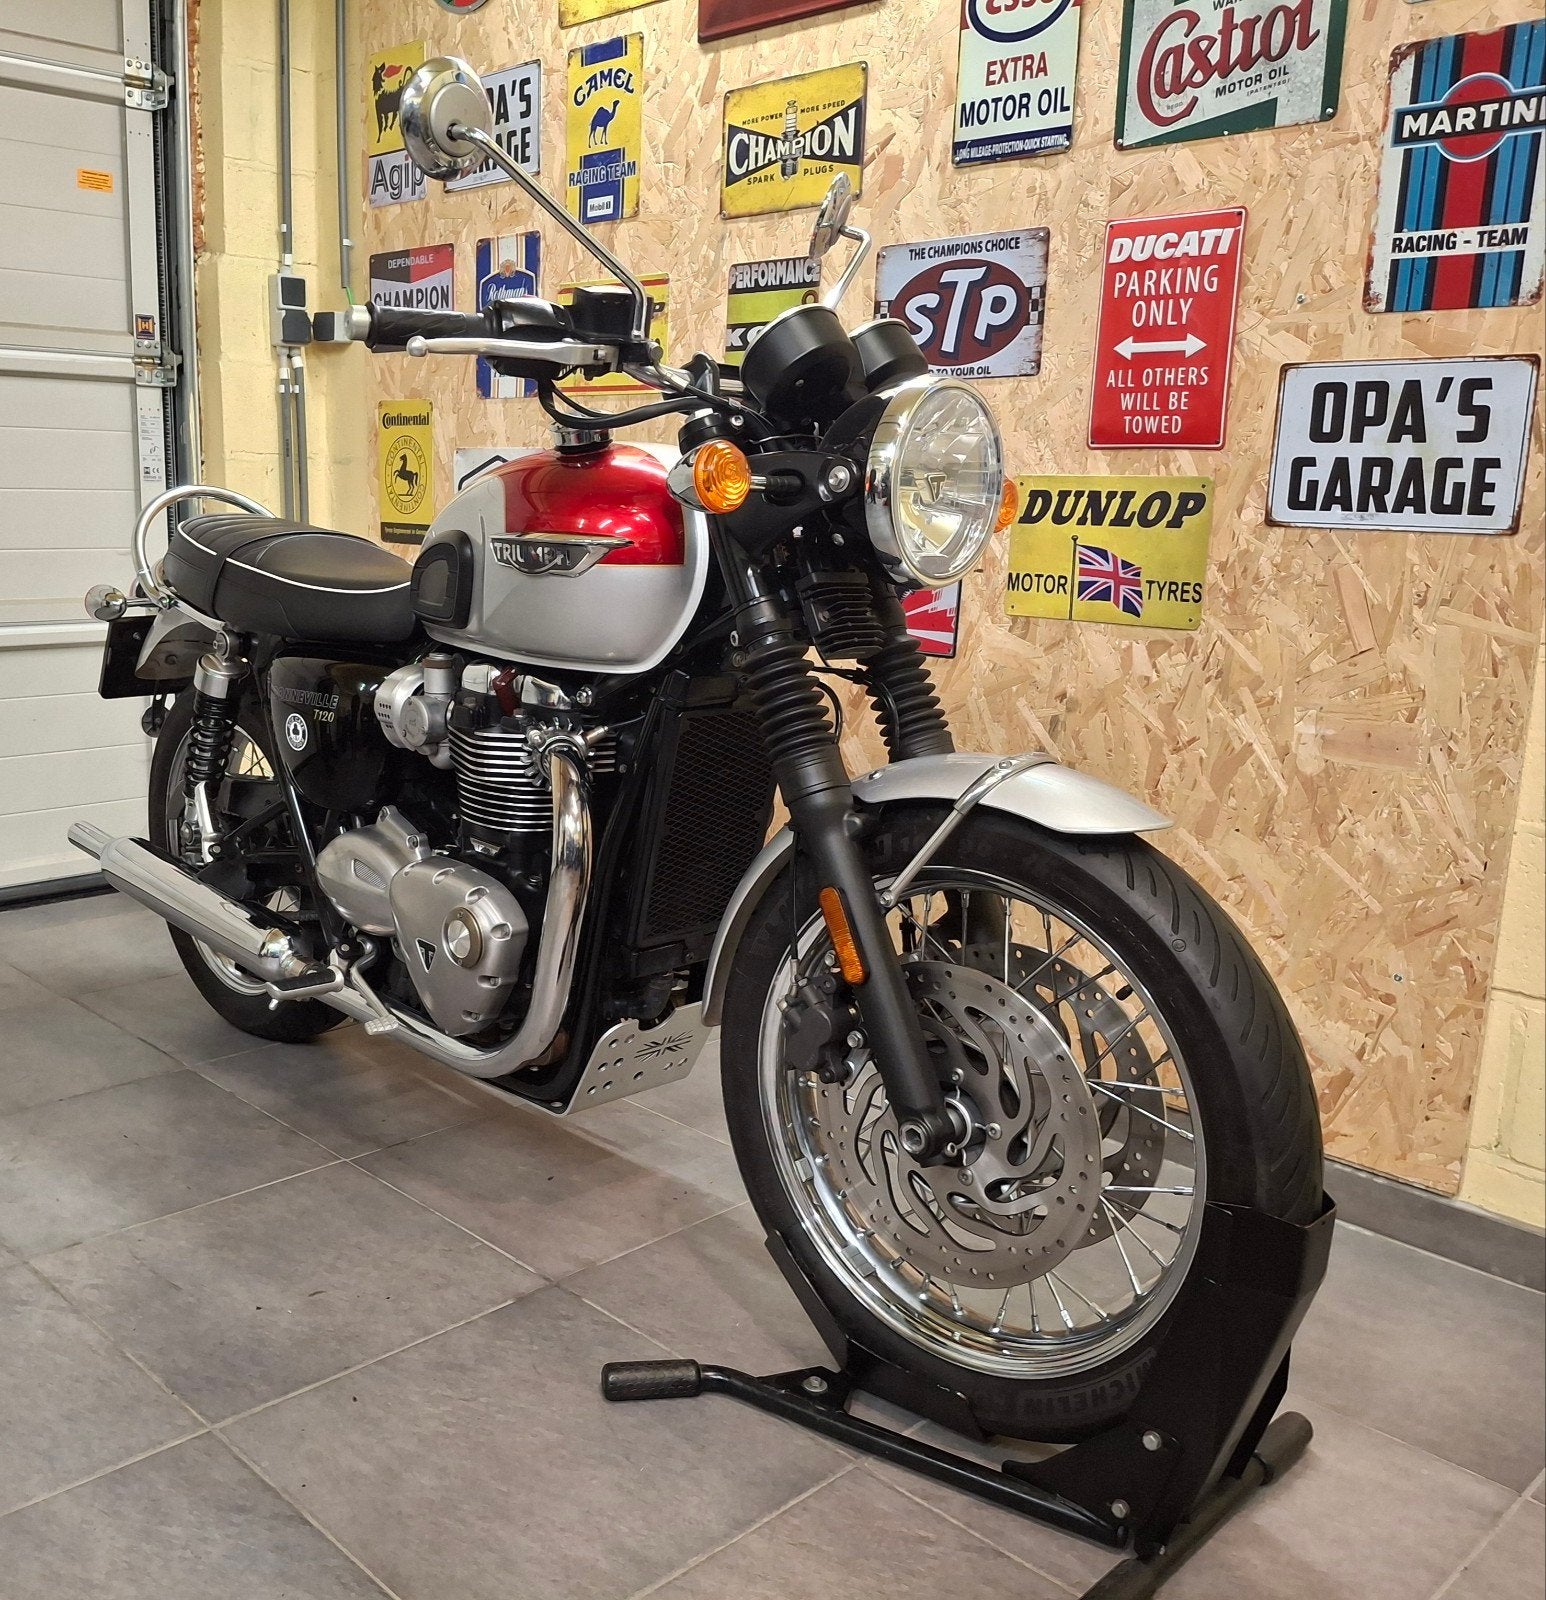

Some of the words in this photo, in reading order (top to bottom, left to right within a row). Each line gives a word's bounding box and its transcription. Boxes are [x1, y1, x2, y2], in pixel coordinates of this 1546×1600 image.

[985, 52, 1048, 87] EXTRA
[1137, 0, 1320, 127] Castrol
[573, 67, 635, 107] CAMEL
[1215, 73, 1262, 98] MOTOR
[1269, 65, 1290, 81] OIL
[486, 77, 532, 125] A'S
[800, 105, 820, 114] MORE
[822, 100, 846, 110] SPEED
[960, 93, 1031, 128] MOTOR
[1037, 86, 1071, 116] OIL
[742, 117, 759, 126] MORE
[760, 112, 783, 121] POWER
[1402, 96, 1546, 139] MARTINI
[473, 126, 532, 174] AGE
[729, 106, 857, 175] CHAMPION
[956, 147, 970, 160] LONG
[1041, 133, 1067, 148] STARTING
[371, 154, 425, 200] Agip
[568, 164, 606, 188] RACING
[608, 160, 636, 180] TEAM
[747, 173, 775, 186] SPARK
[803, 164, 835, 176] PLUGS
[589, 202, 605, 212] Mobil
[909, 247, 926, 262] THE
[927, 240, 983, 259] CHAMPIONS
[985, 236, 1021, 252] CHOICE
[1108, 227, 1236, 264] DUCATI
[1392, 232, 1457, 254] RACING
[1476, 226, 1528, 249] TEAM
[388, 253, 434, 269] DEPENDABLE
[729, 258, 821, 289] PERFORMANCE
[1114, 264, 1219, 298] PARKING
[374, 285, 449, 309] CHAMPION
[904, 266, 1018, 353] STP
[1131, 297, 1193, 328] ONLY
[949, 367, 975, 377] YOUR
[976, 365, 992, 375] OIL
[1107, 367, 1134, 389] ALL
[1142, 366, 1210, 387] OTHERS
[1121, 391, 1163, 411] WILL
[1168, 391, 1189, 410] BE
[1308, 376, 1493, 444] OPA'S
[382, 412, 430, 429] Continental
[1123, 415, 1182, 435] TOWED
[1287, 456, 1502, 516] GARAGE
[1018, 489, 1207, 529] DUNLOP
[1007, 572, 1068, 595] MOTOR
[1145, 580, 1203, 604] TYRES
[313, 709, 336, 723] T120
